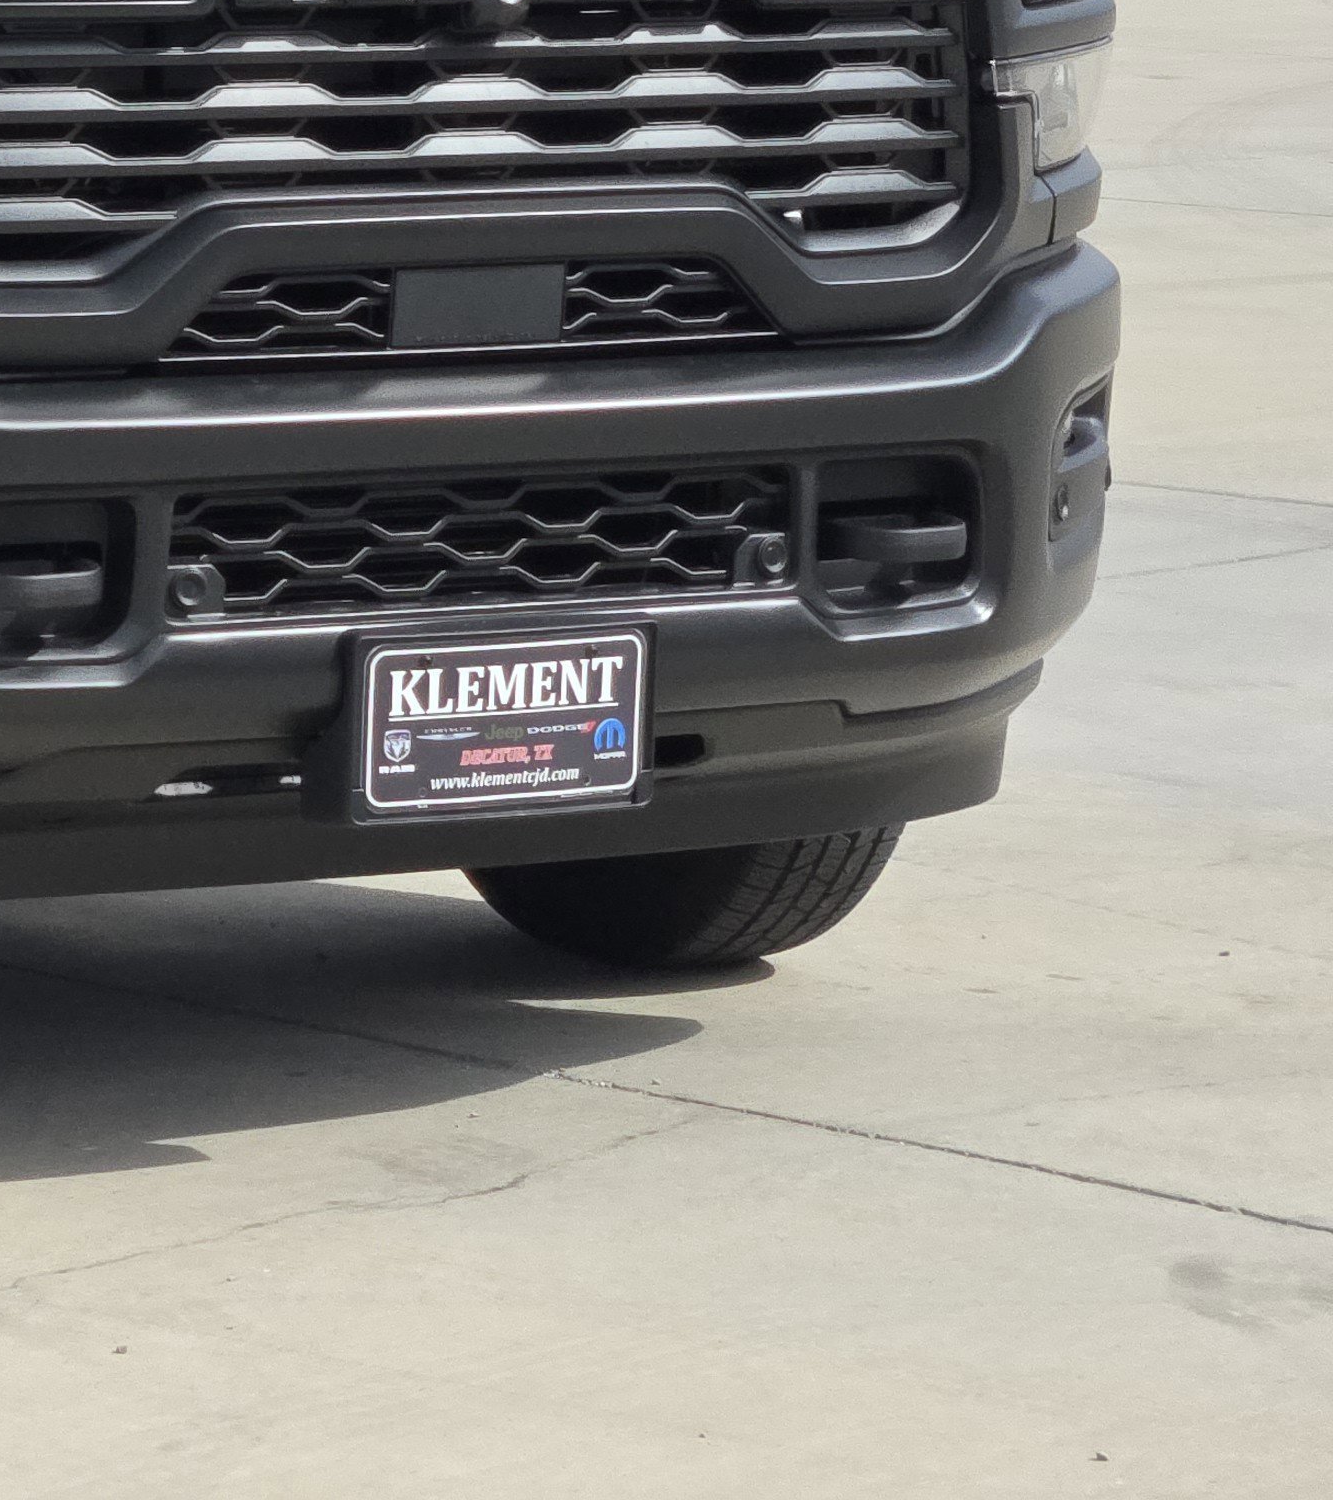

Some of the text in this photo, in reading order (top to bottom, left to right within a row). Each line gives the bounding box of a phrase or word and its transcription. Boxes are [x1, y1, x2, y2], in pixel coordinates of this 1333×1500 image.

[388, 655, 623, 717] KLEMENT
[485, 723, 525, 741] Jeep
[527, 723, 589, 735] DODGE
[534, 743, 555, 761] TX
[430, 766, 580, 791] www.klementcjd.com
